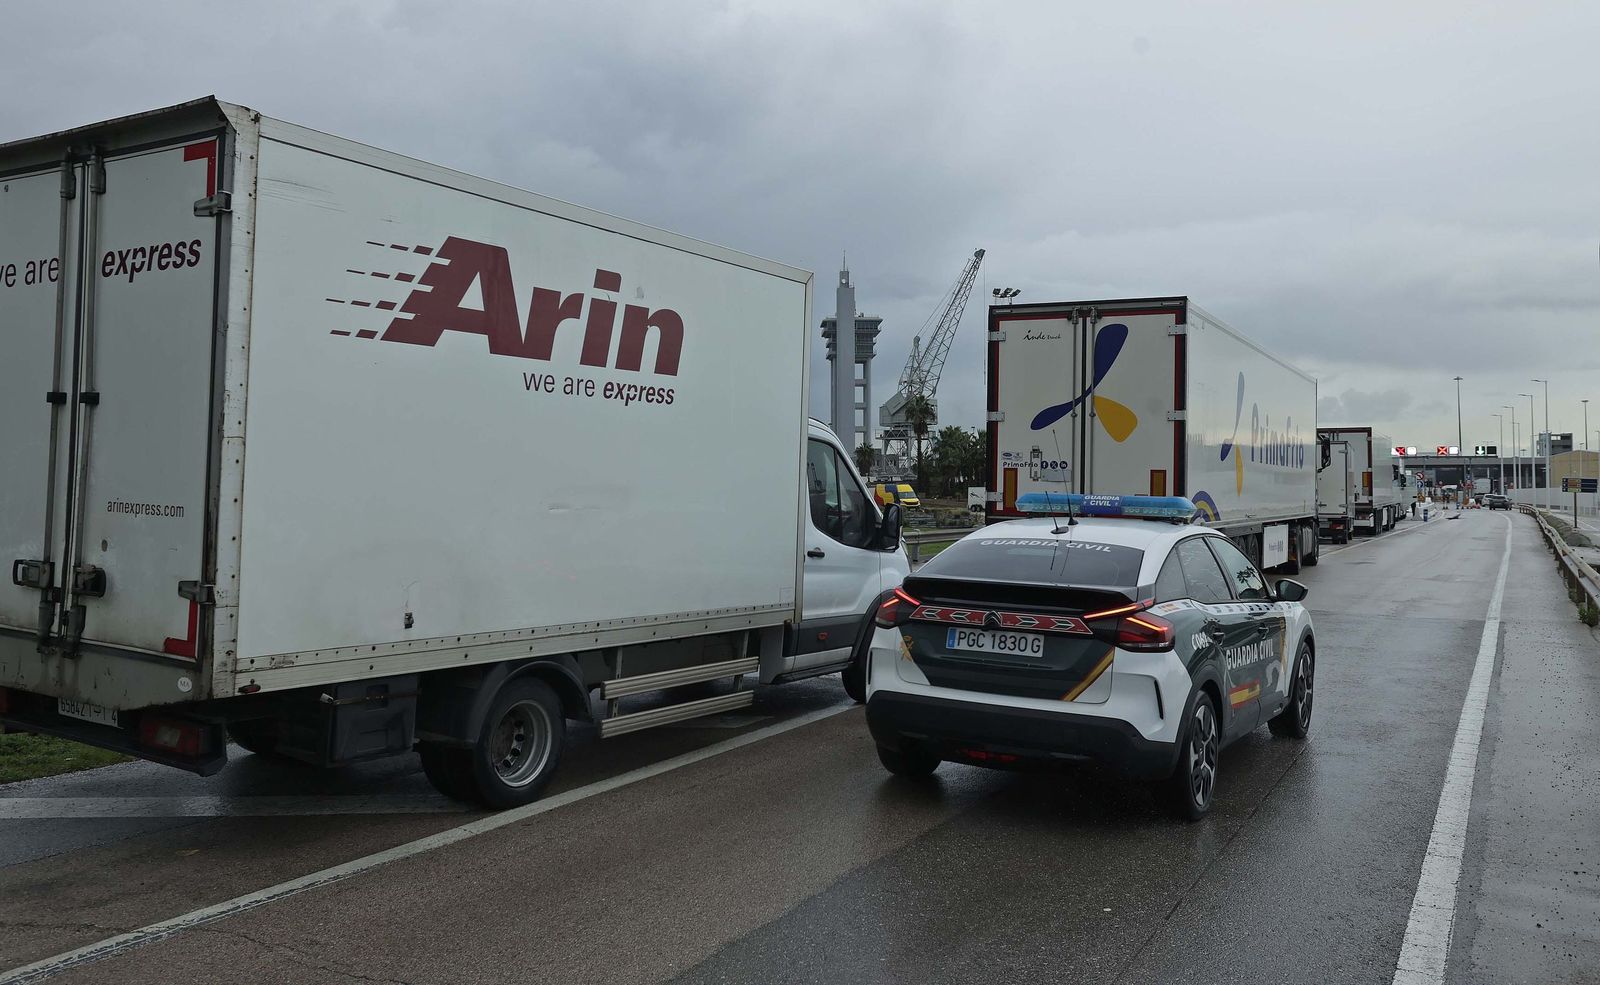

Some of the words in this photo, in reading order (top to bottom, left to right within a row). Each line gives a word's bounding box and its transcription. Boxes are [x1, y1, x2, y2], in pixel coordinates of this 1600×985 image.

[25, 257, 59, 285] are
[101, 239, 202, 283] express
[380, 235, 685, 376] Arin
[522, 372, 555, 393] we
[563, 377, 595, 397] are
[603, 380, 675, 406] express
[107, 498, 185, 518] arinexpress.com
[980, 539, 1060, 548] GUARDIA
[1065, 541, 1112, 553] CIVIL
[957, 630, 986, 648] PGC
[991, 633, 1028, 652] 1830
[1031, 637, 1042, 654] G
[1225, 643, 1258, 670] GUARDIA
[1259, 638, 1274, 660] CIVIL
